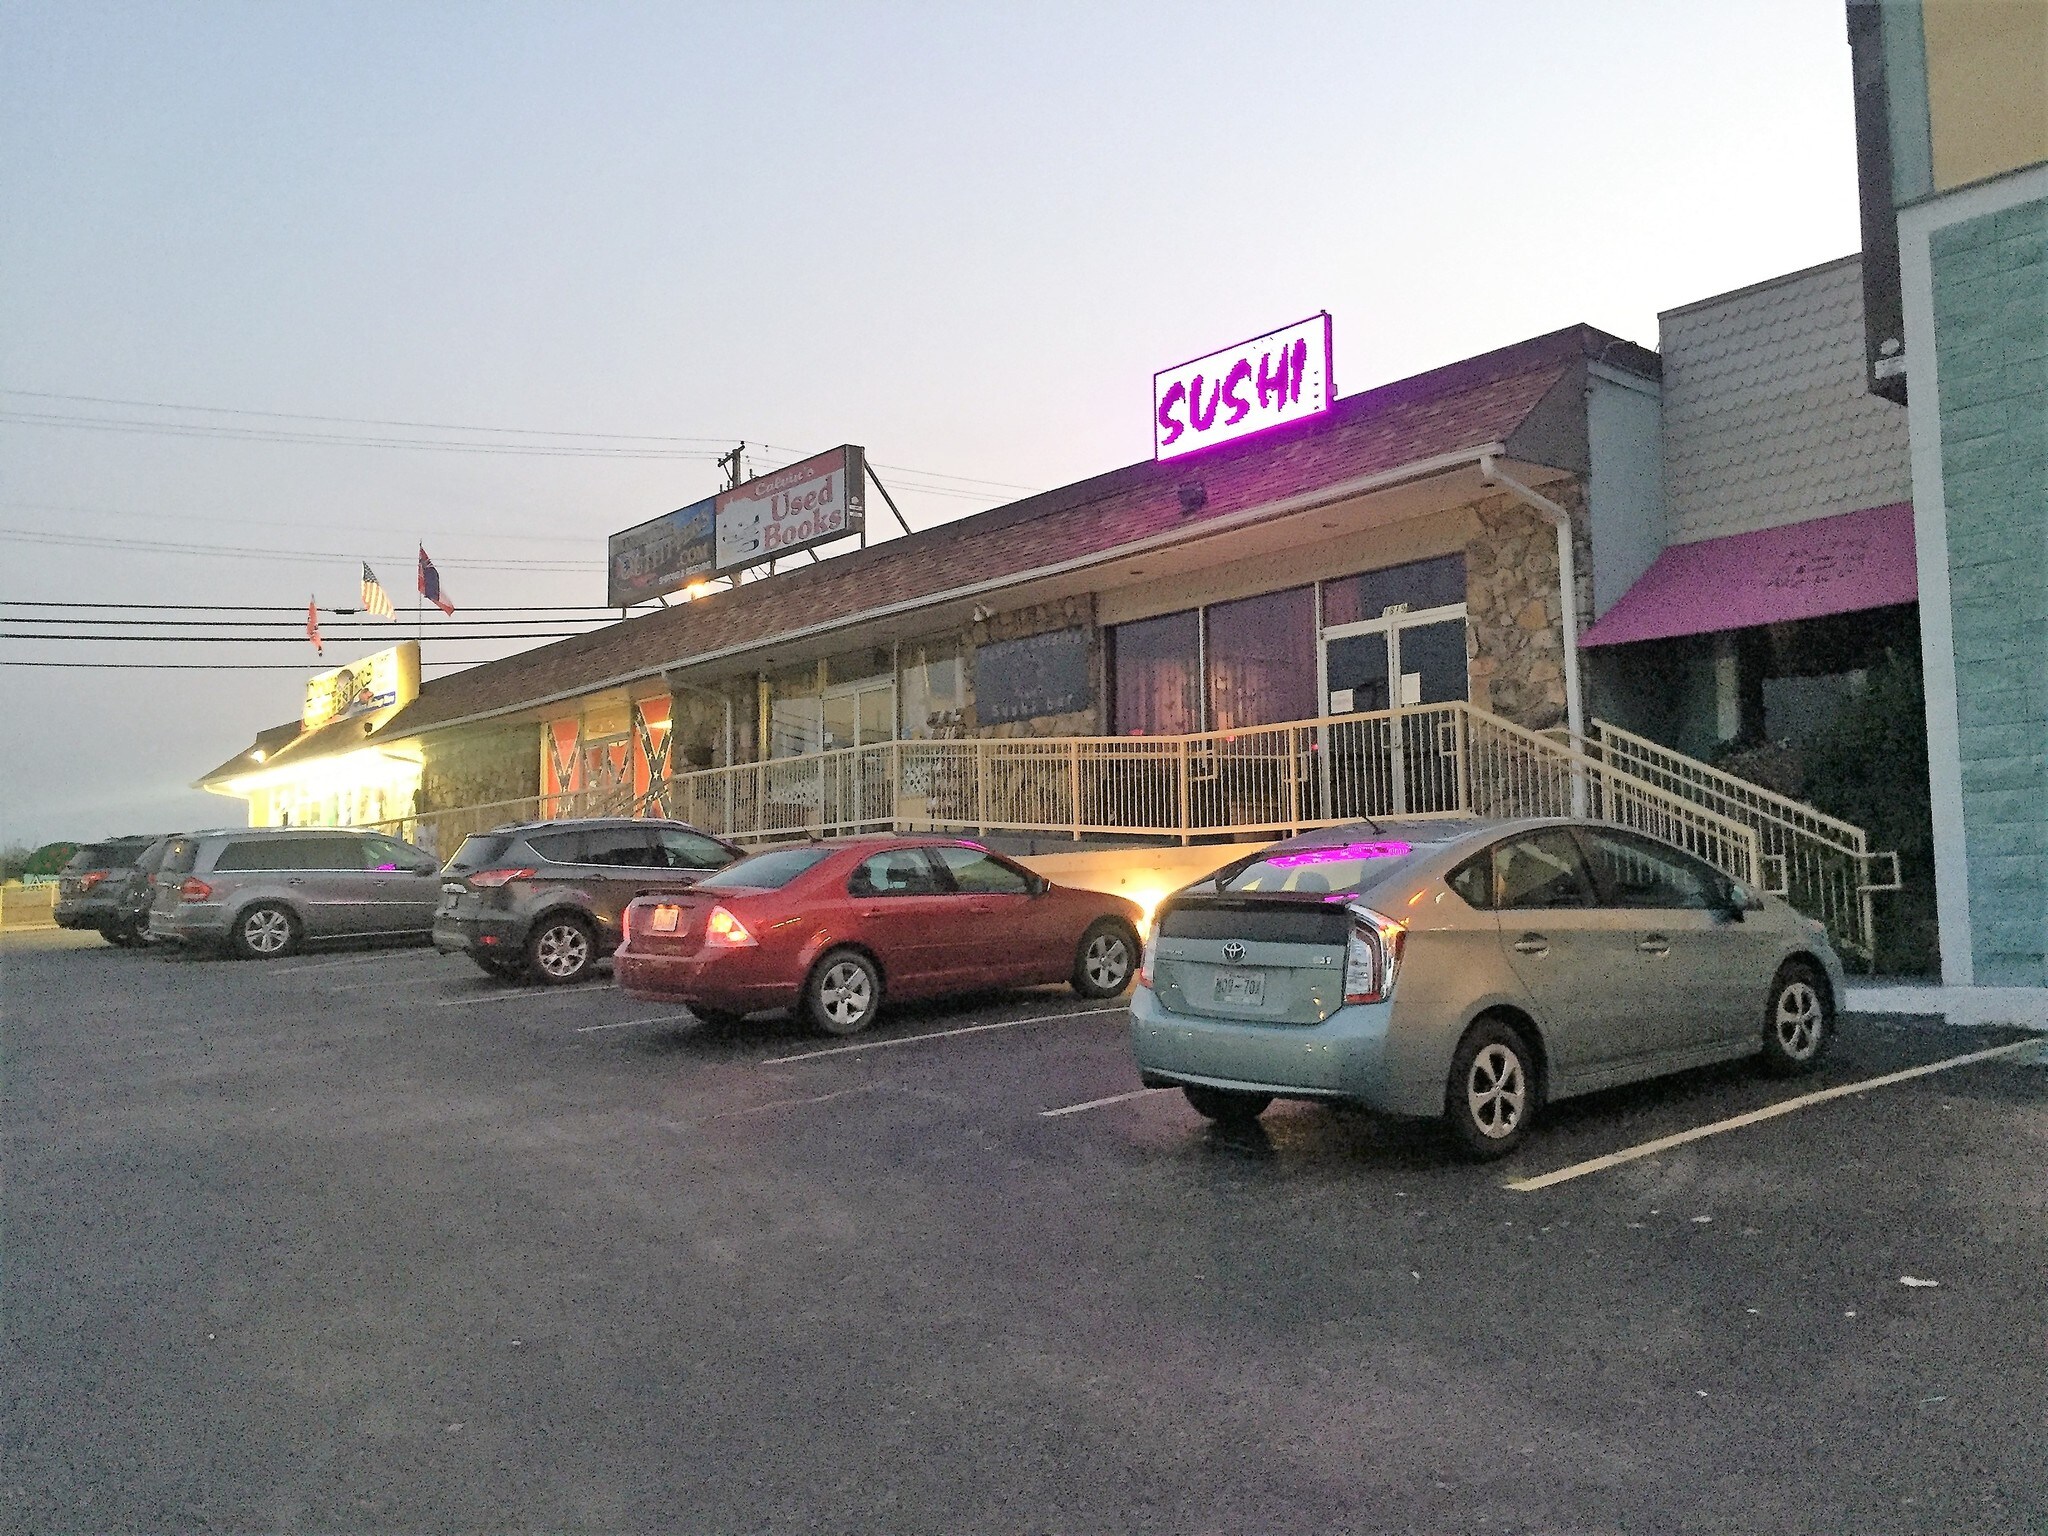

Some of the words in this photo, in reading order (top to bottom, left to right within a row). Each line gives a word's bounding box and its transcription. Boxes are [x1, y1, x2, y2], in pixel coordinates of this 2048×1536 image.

[1159, 338, 1307, 446] SUSHI
[771, 475, 833, 522] Used
[764, 508, 842, 550] Books
